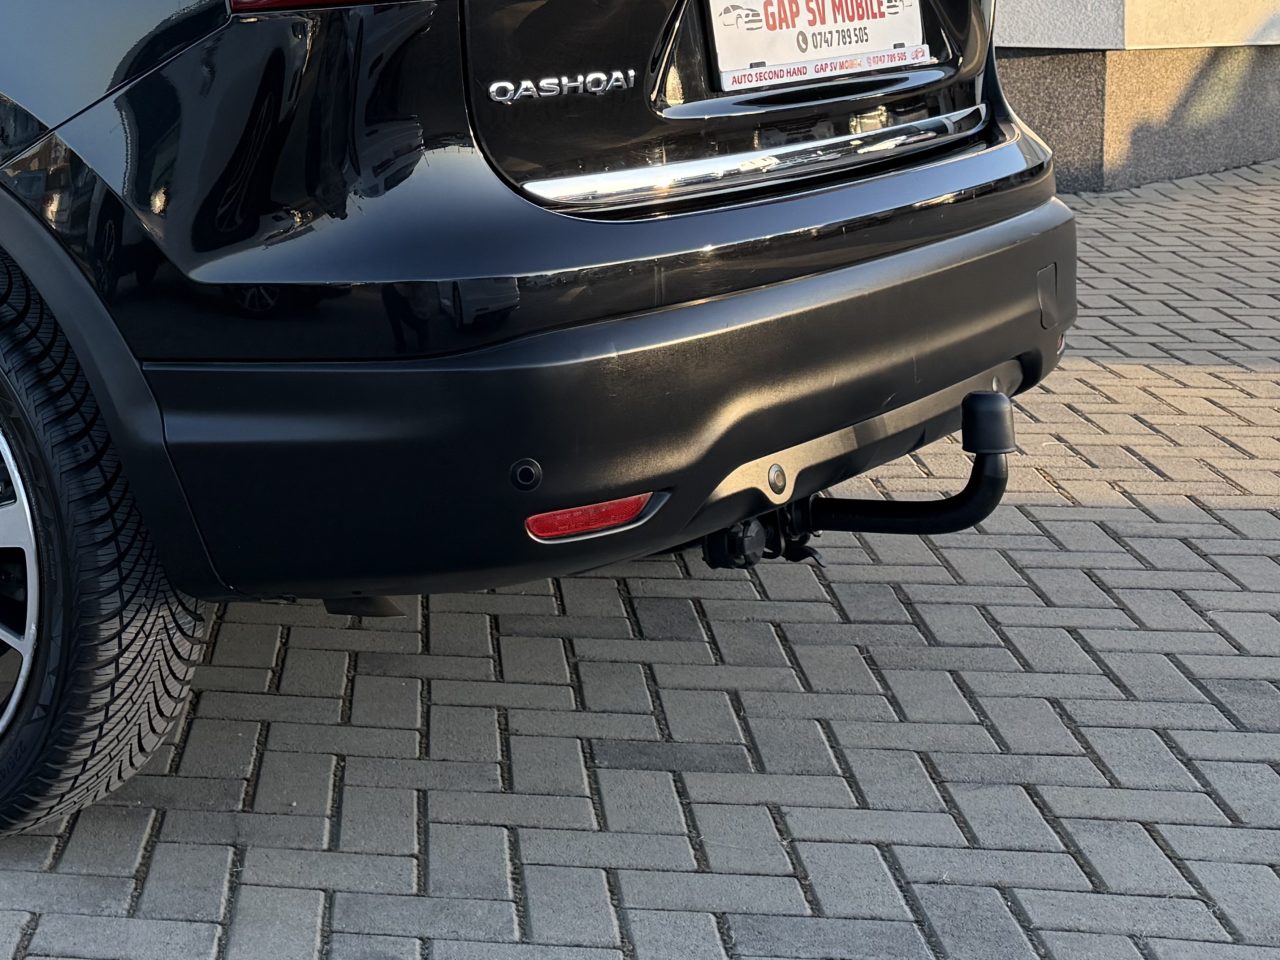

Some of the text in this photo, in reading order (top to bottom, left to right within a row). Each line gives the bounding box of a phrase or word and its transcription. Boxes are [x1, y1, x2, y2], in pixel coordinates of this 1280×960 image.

[811, 26, 869, 50] 0747 789 505
[731, 65, 808, 86] AUTO SECOND HAND
[814, 63, 829, 74] GAP
[829, 61, 838, 72] SV
[489, 69, 635, 104] QASHQAI
